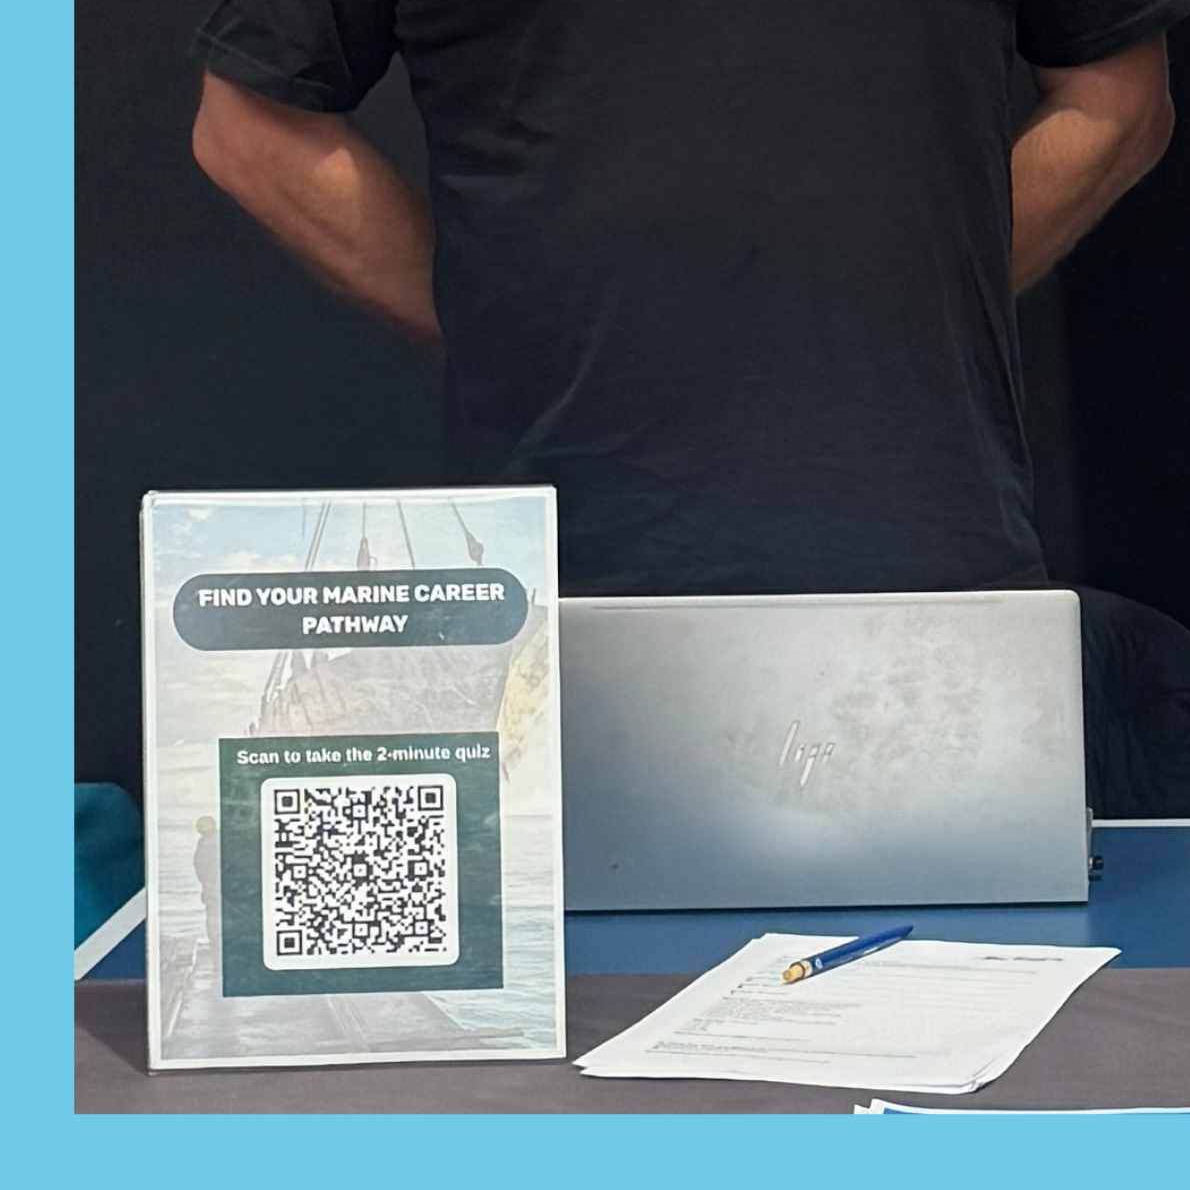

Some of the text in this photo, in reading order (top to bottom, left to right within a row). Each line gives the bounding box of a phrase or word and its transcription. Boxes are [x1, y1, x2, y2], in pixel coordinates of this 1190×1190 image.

[198, 582, 505, 607] FIND YOUR MARINE CAREER
[302, 614, 409, 635] PATHWAY
[236, 743, 491, 765] Scan to take the 2-minute quiz
